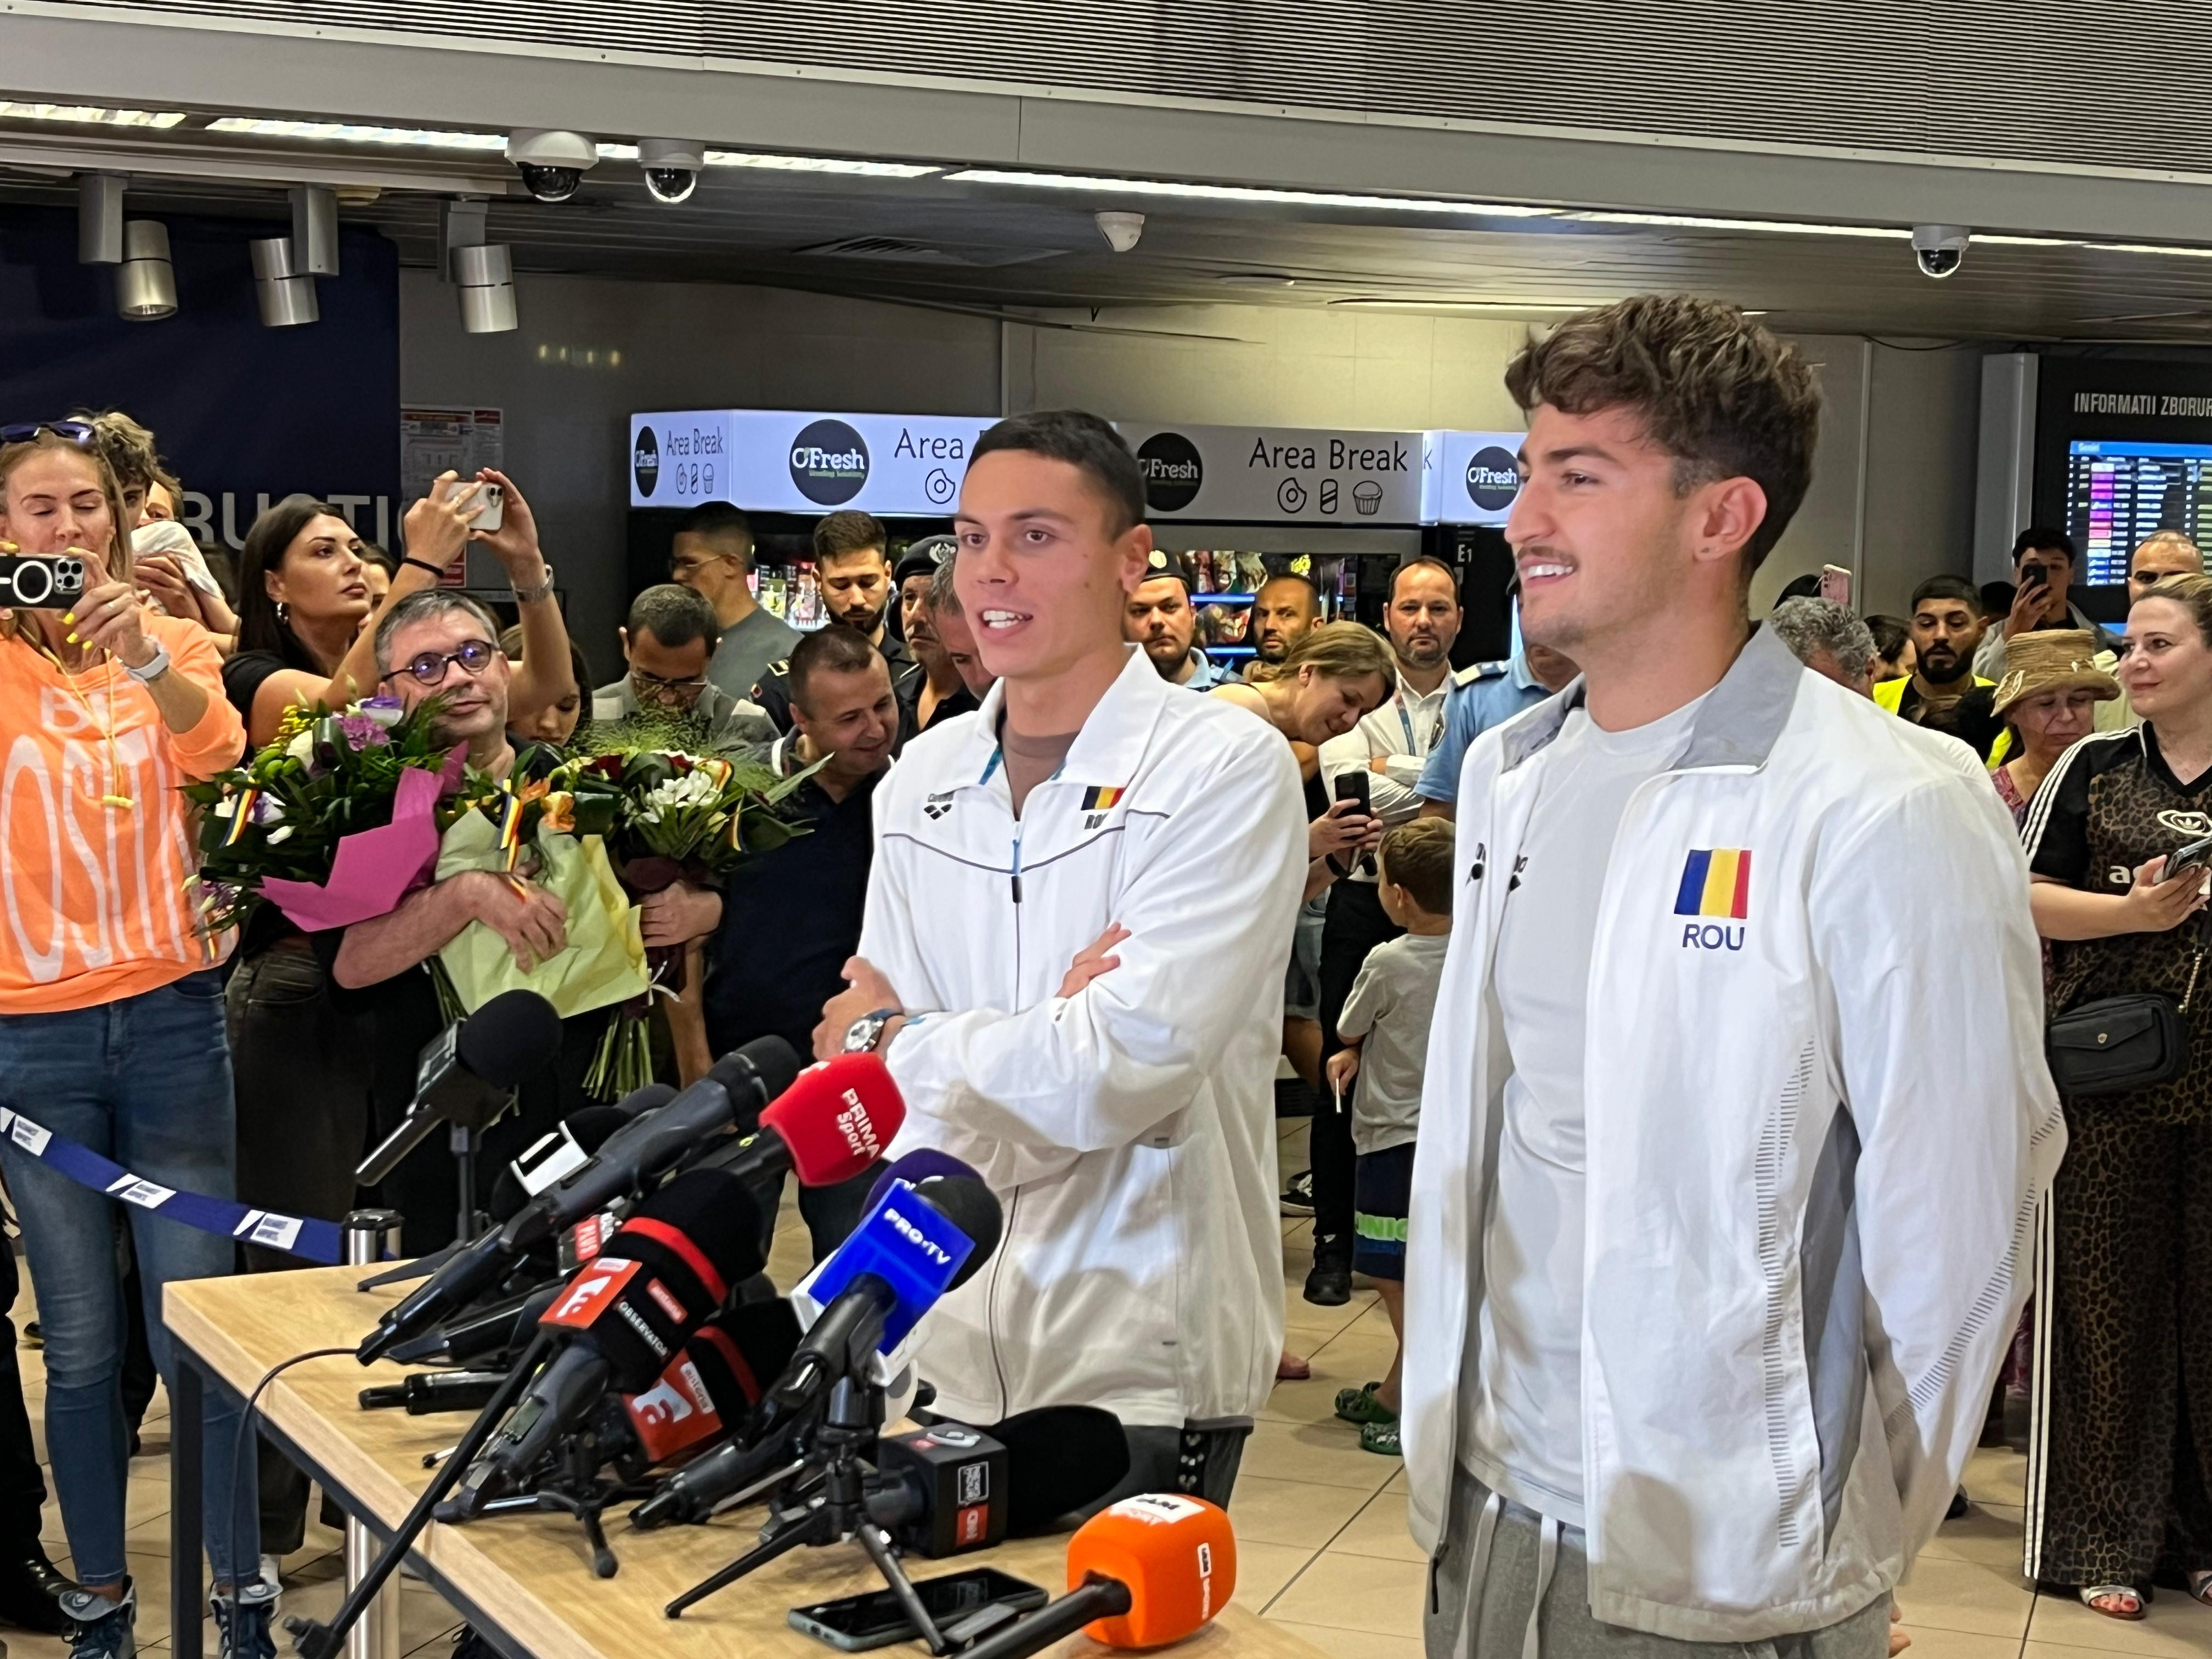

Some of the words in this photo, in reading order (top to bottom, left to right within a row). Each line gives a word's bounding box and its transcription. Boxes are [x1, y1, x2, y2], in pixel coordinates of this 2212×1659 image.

[2074, 393, 2157, 415] INFORMATII
[666, 430, 690, 456] Area
[693, 426, 724, 455] Break
[894, 428, 963, 459] Area
[1249, 437, 1316, 470] Area
[1330, 439, 1408, 472] Break
[1457, 544, 1472, 562] E1
[1682, 924, 1745, 951] ROU
[842, 1088, 881, 1159] PRIMA
